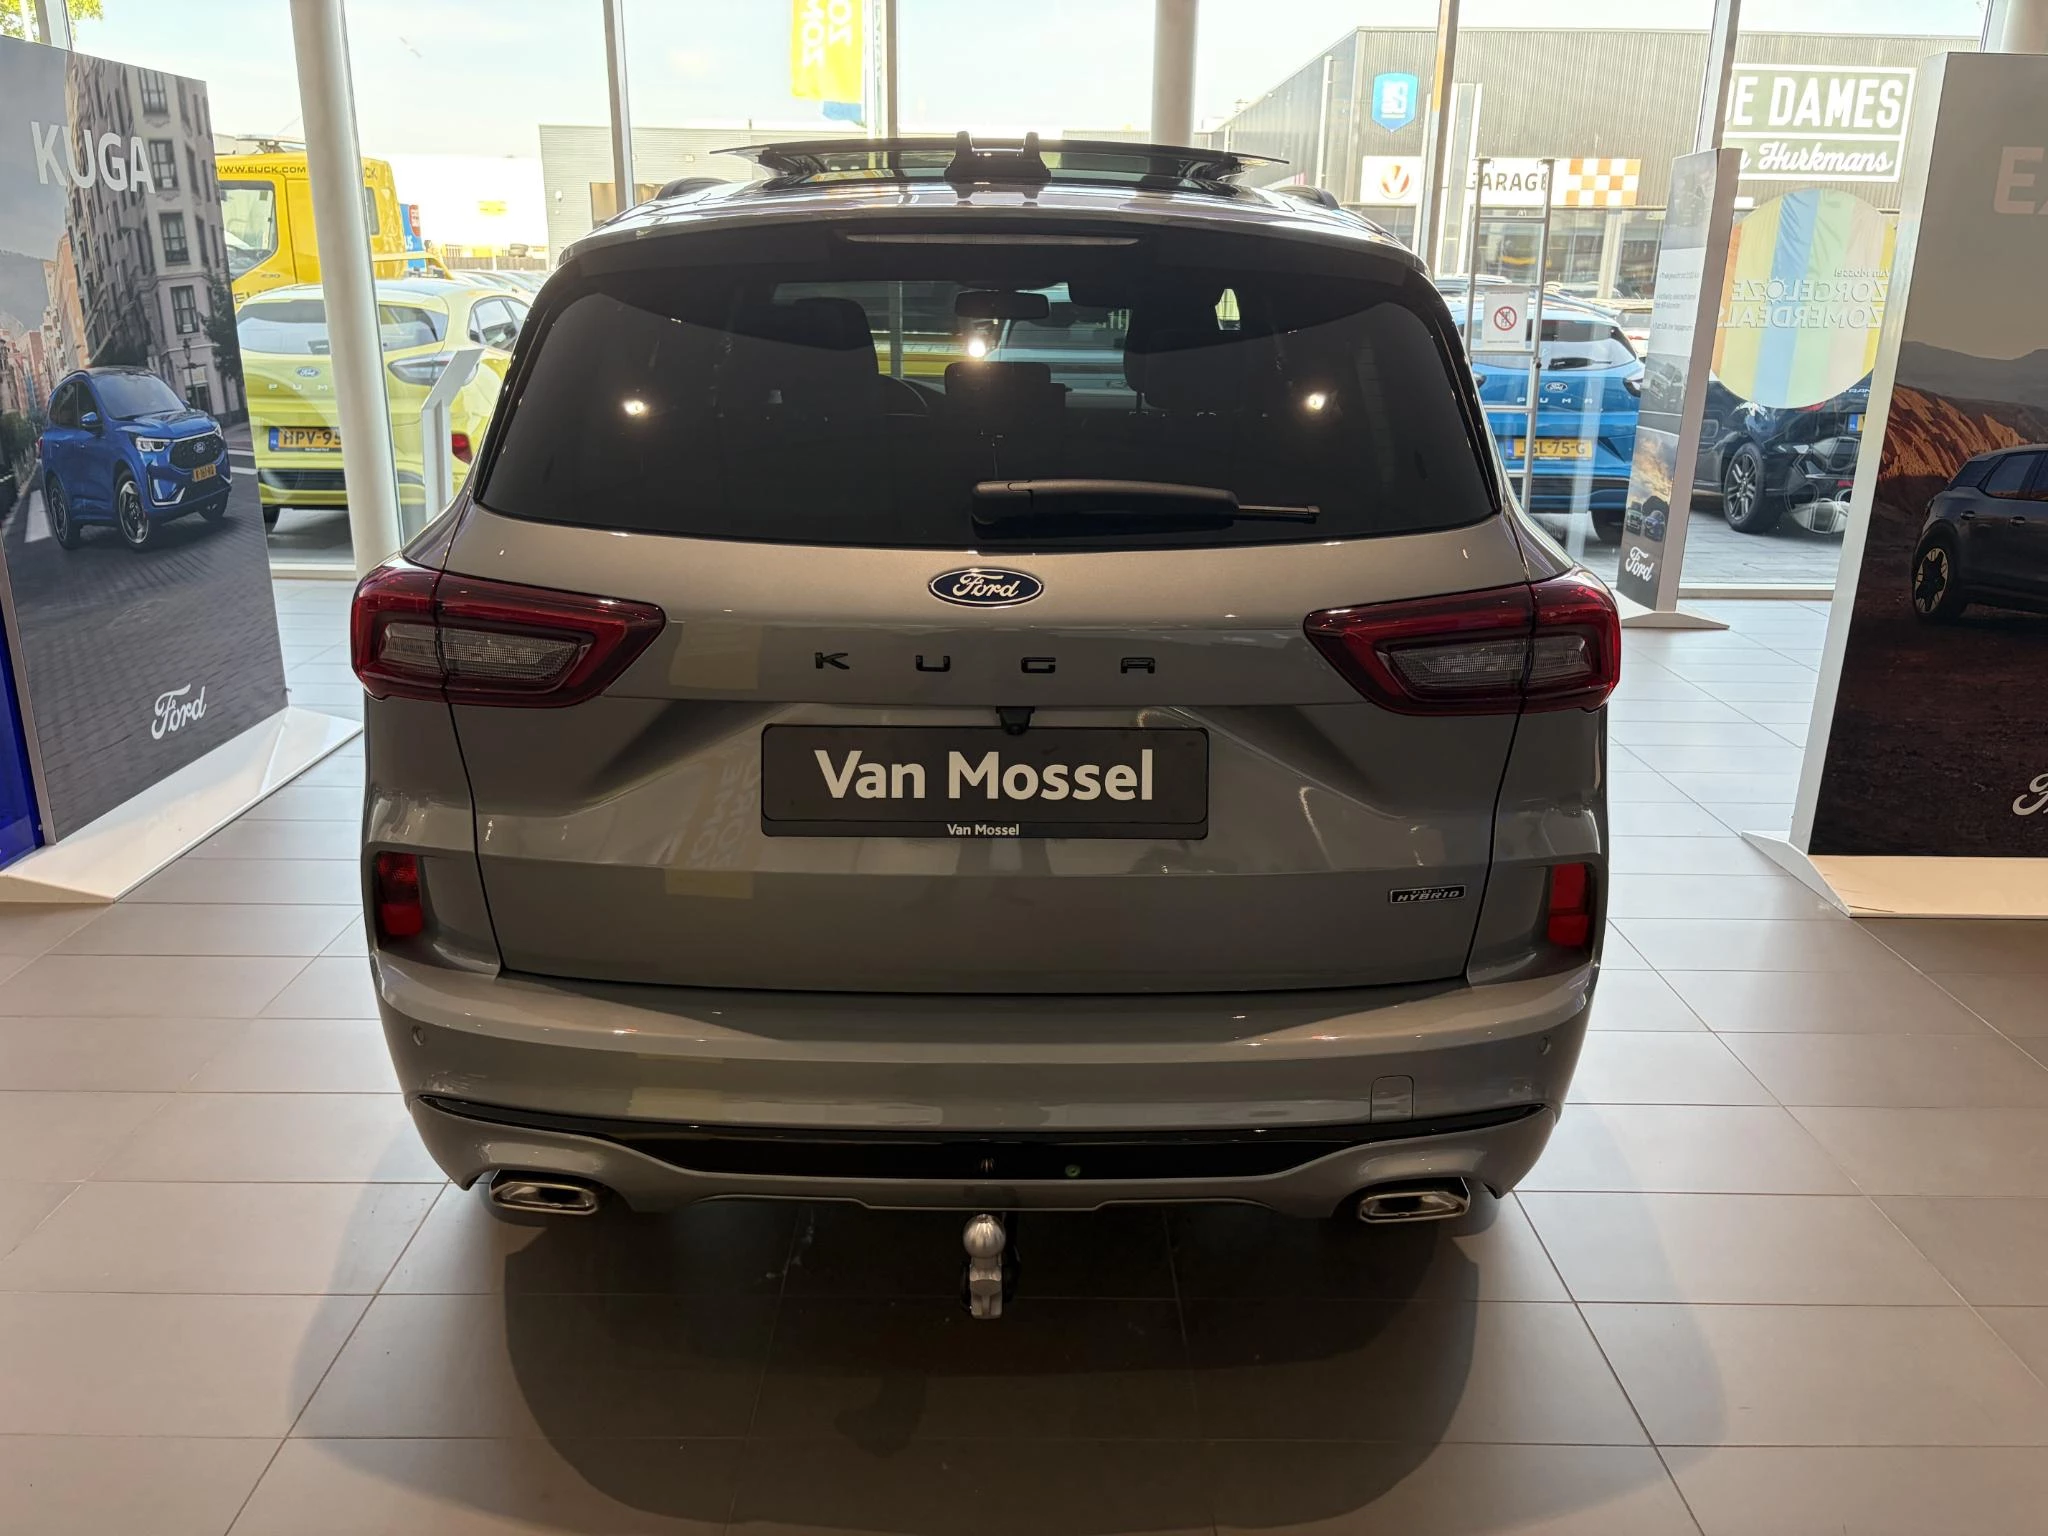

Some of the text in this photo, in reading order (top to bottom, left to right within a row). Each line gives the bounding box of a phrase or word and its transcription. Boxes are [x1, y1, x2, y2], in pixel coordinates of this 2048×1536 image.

[1767, 76, 1904, 129] DAMES
[30, 121, 156, 194] KUGA
[1758, 141, 1894, 173] Hurkmans
[1994, 146, 2048, 215] E
[1625, 546, 1655, 582] Ford
[952, 572, 1021, 597] Ford
[814, 651, 1156, 675] KUGA
[151, 683, 207, 740] Ford
[814, 749, 1153, 800] Van Mossel
[947, 823, 1020, 836] Van Mossel
[1397, 890, 1460, 902] HYBRID
